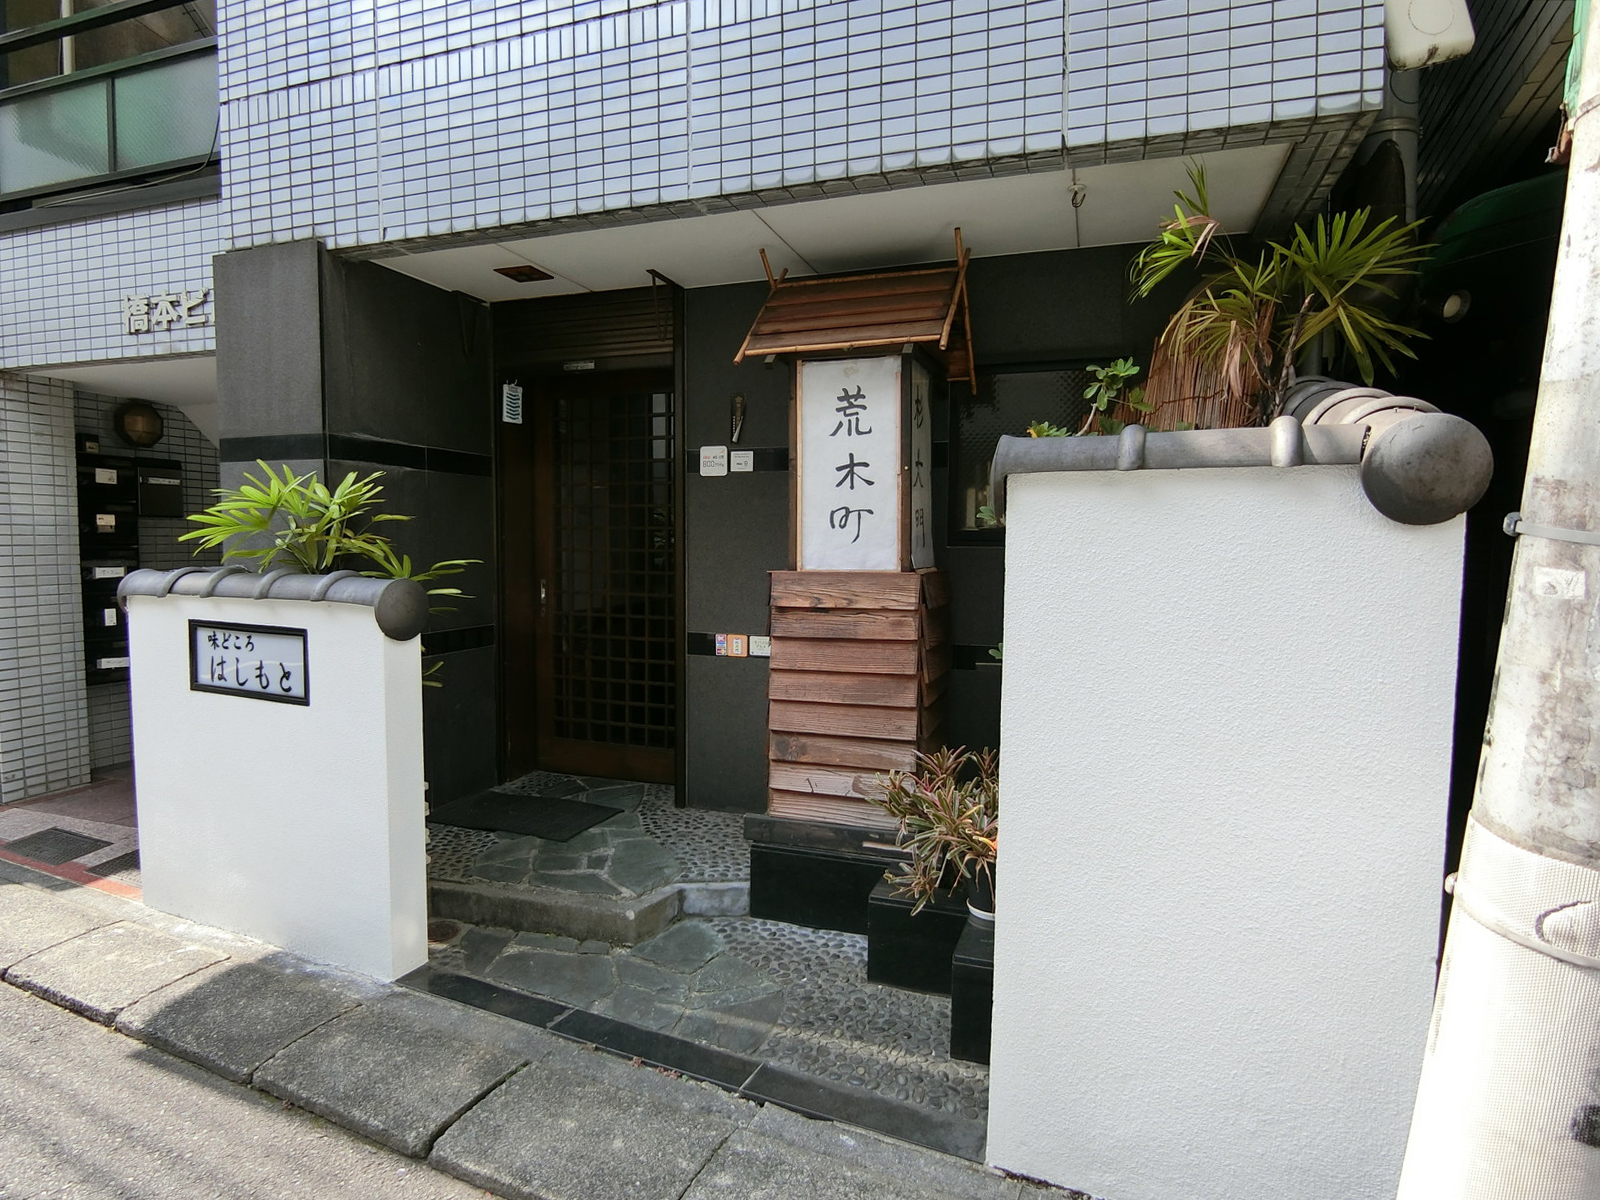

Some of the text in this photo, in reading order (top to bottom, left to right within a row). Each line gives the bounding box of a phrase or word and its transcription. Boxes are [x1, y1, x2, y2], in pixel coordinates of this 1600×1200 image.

[123, 288, 215, 334] 橋本ビ
[829, 385, 875, 544] 荒木町
[208, 630, 255, 652] 味どころ
[210, 655, 293, 693] はしもと
